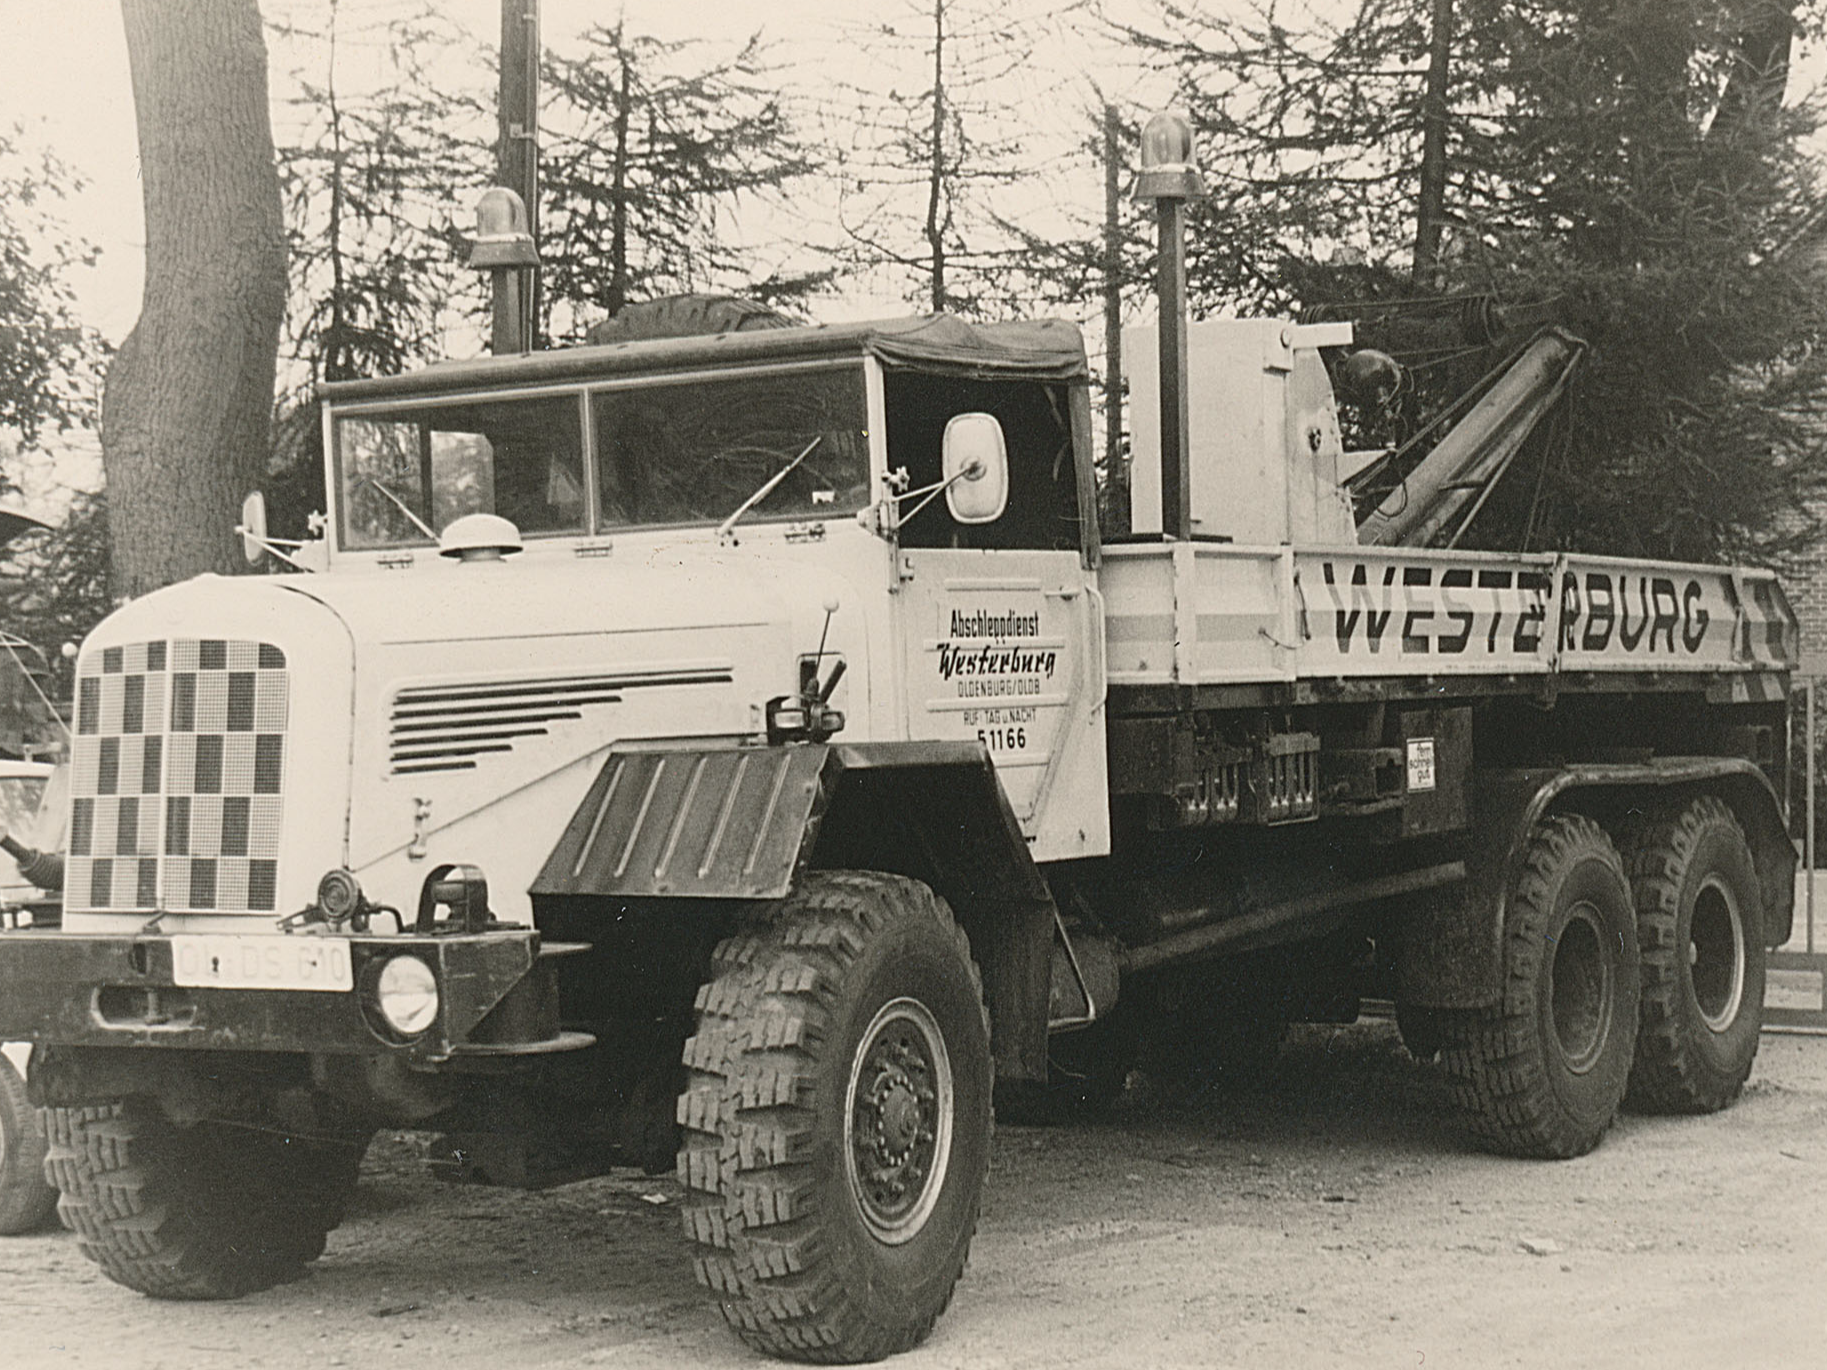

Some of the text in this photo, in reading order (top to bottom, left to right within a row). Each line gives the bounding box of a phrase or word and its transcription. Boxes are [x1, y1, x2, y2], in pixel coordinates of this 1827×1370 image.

[1323, 562, 1709, 653] WESTERBURG
[950, 609, 1039, 645] Abschleppdienst
[936, 643, 1056, 681] Westerburg
[985, 710, 1000, 724] TAG
[978, 727, 1026, 751] 51166
